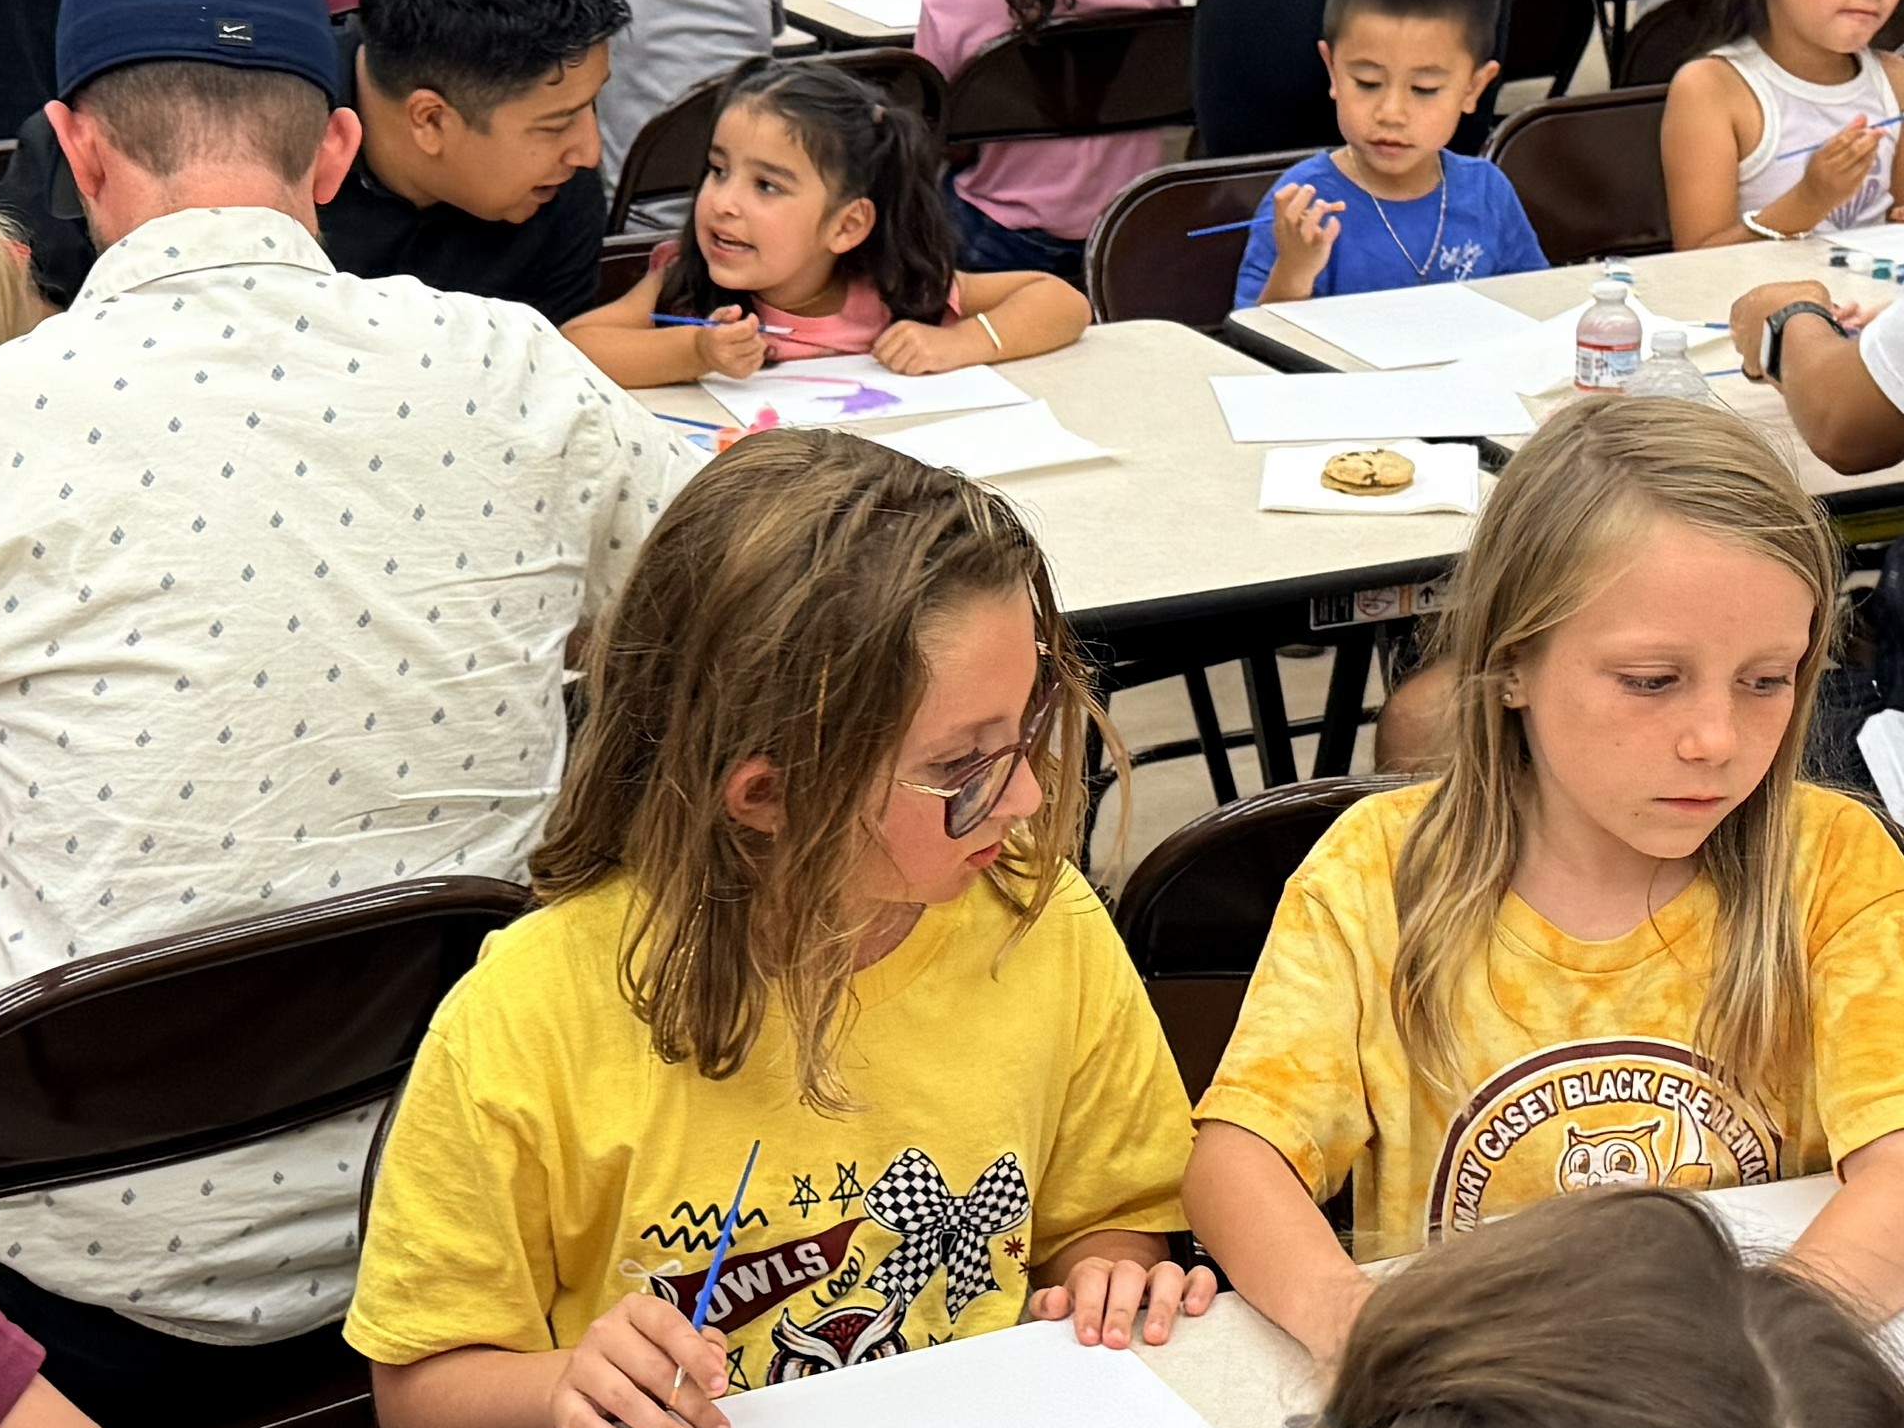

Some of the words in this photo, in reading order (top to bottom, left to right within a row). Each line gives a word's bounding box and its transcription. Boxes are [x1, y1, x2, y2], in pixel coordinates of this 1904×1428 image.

[1452, 1150, 1491, 1233] MARY
[1475, 1080, 1560, 1161] CASEY
[1559, 1067, 1654, 1110] BLACK
[696, 1242, 830, 1323] OWLS
